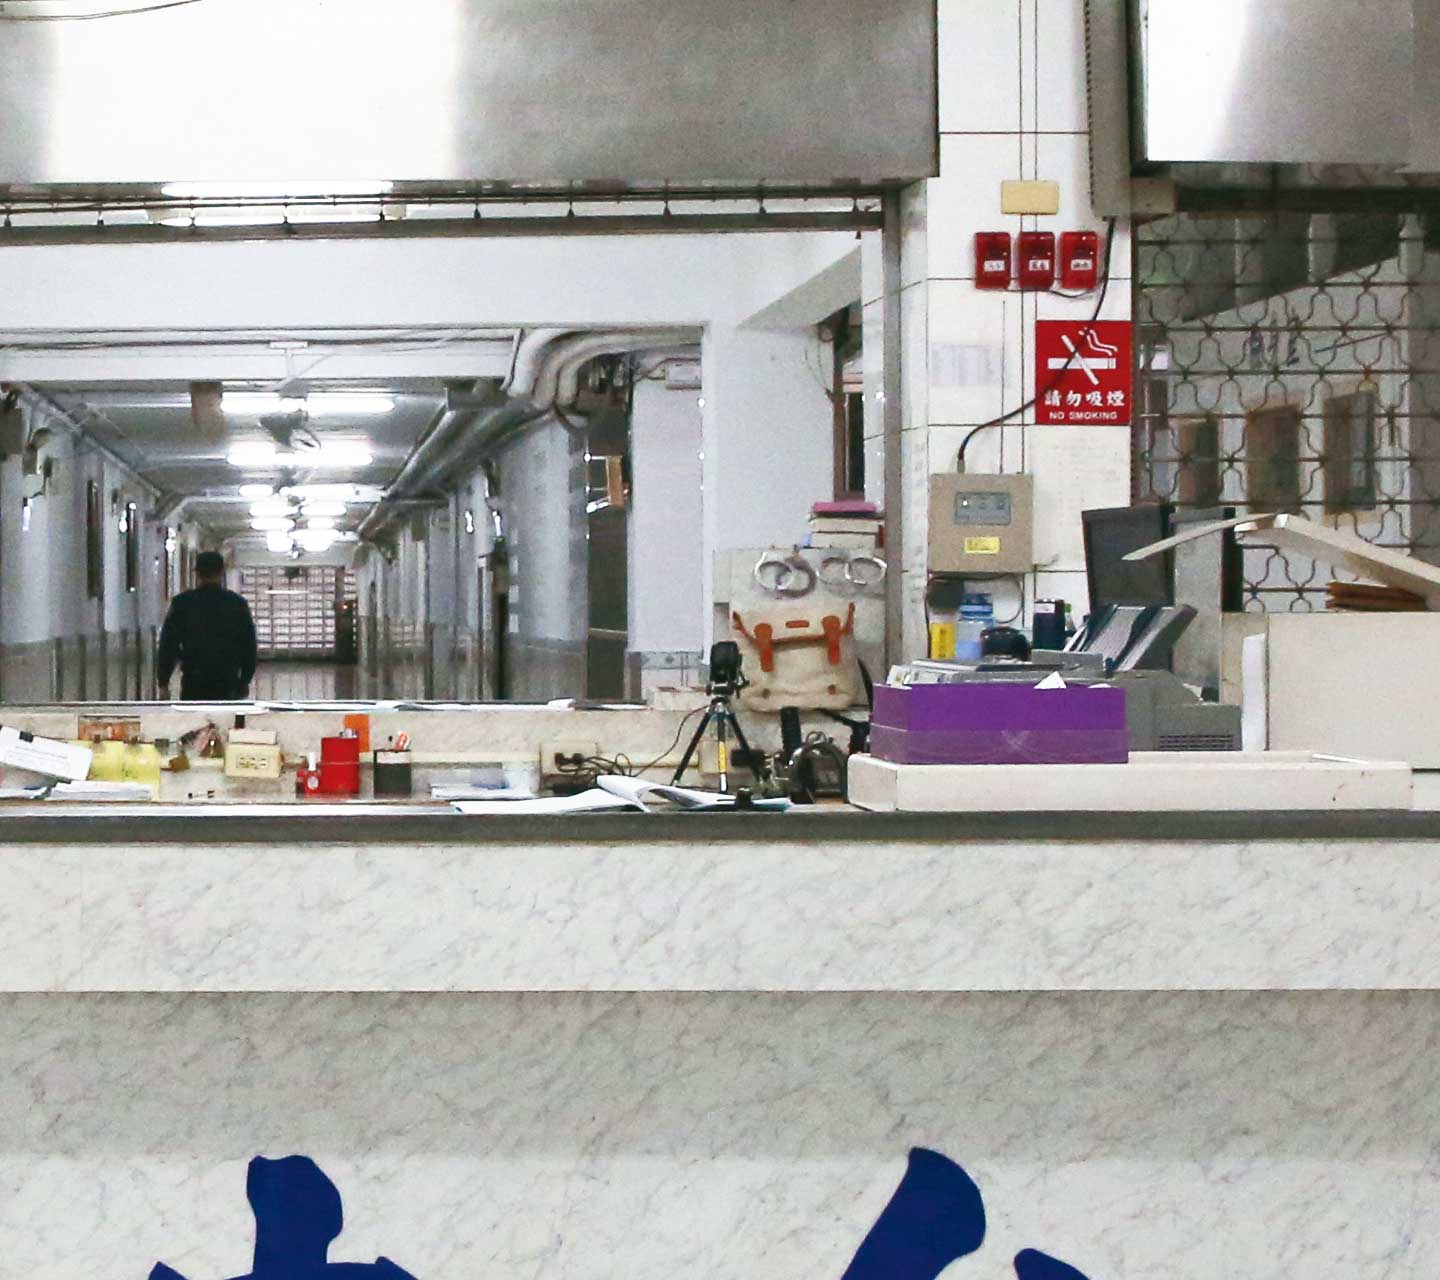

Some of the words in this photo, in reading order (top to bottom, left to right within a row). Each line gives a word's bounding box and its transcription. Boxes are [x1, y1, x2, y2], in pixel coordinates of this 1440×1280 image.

[1044, 389, 1125, 407] 請勿吸煙
[1049, 411, 1064, 420] NO
[1069, 411, 1117, 420] SMOKING
